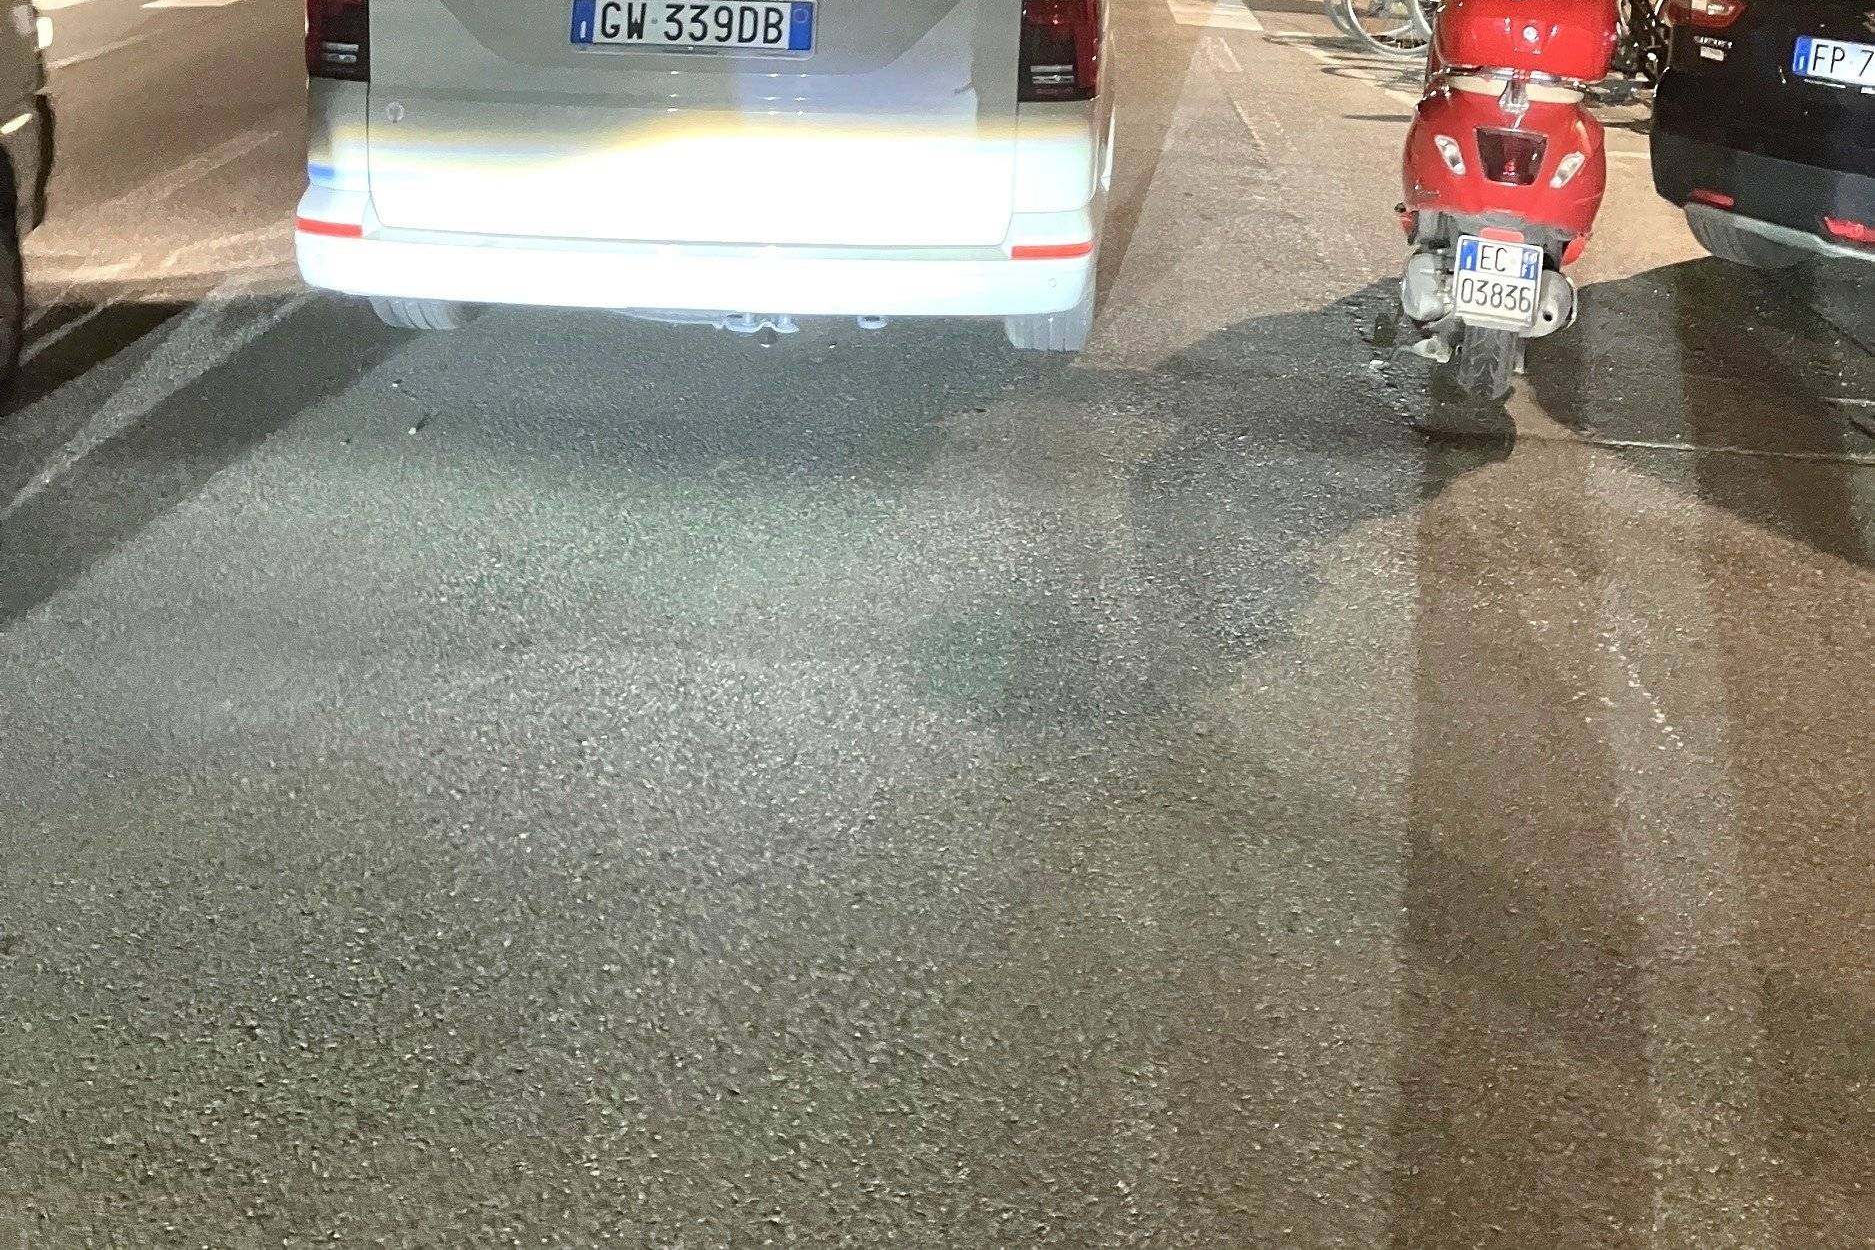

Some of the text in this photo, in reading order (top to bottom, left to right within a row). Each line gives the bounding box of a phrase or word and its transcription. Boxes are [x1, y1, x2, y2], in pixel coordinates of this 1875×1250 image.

[600, 1, 784, 45] GW 339DB
[1812, 43, 1846, 74] FP
[1480, 244, 1508, 272] EC
[1461, 277, 1532, 313] 03836
